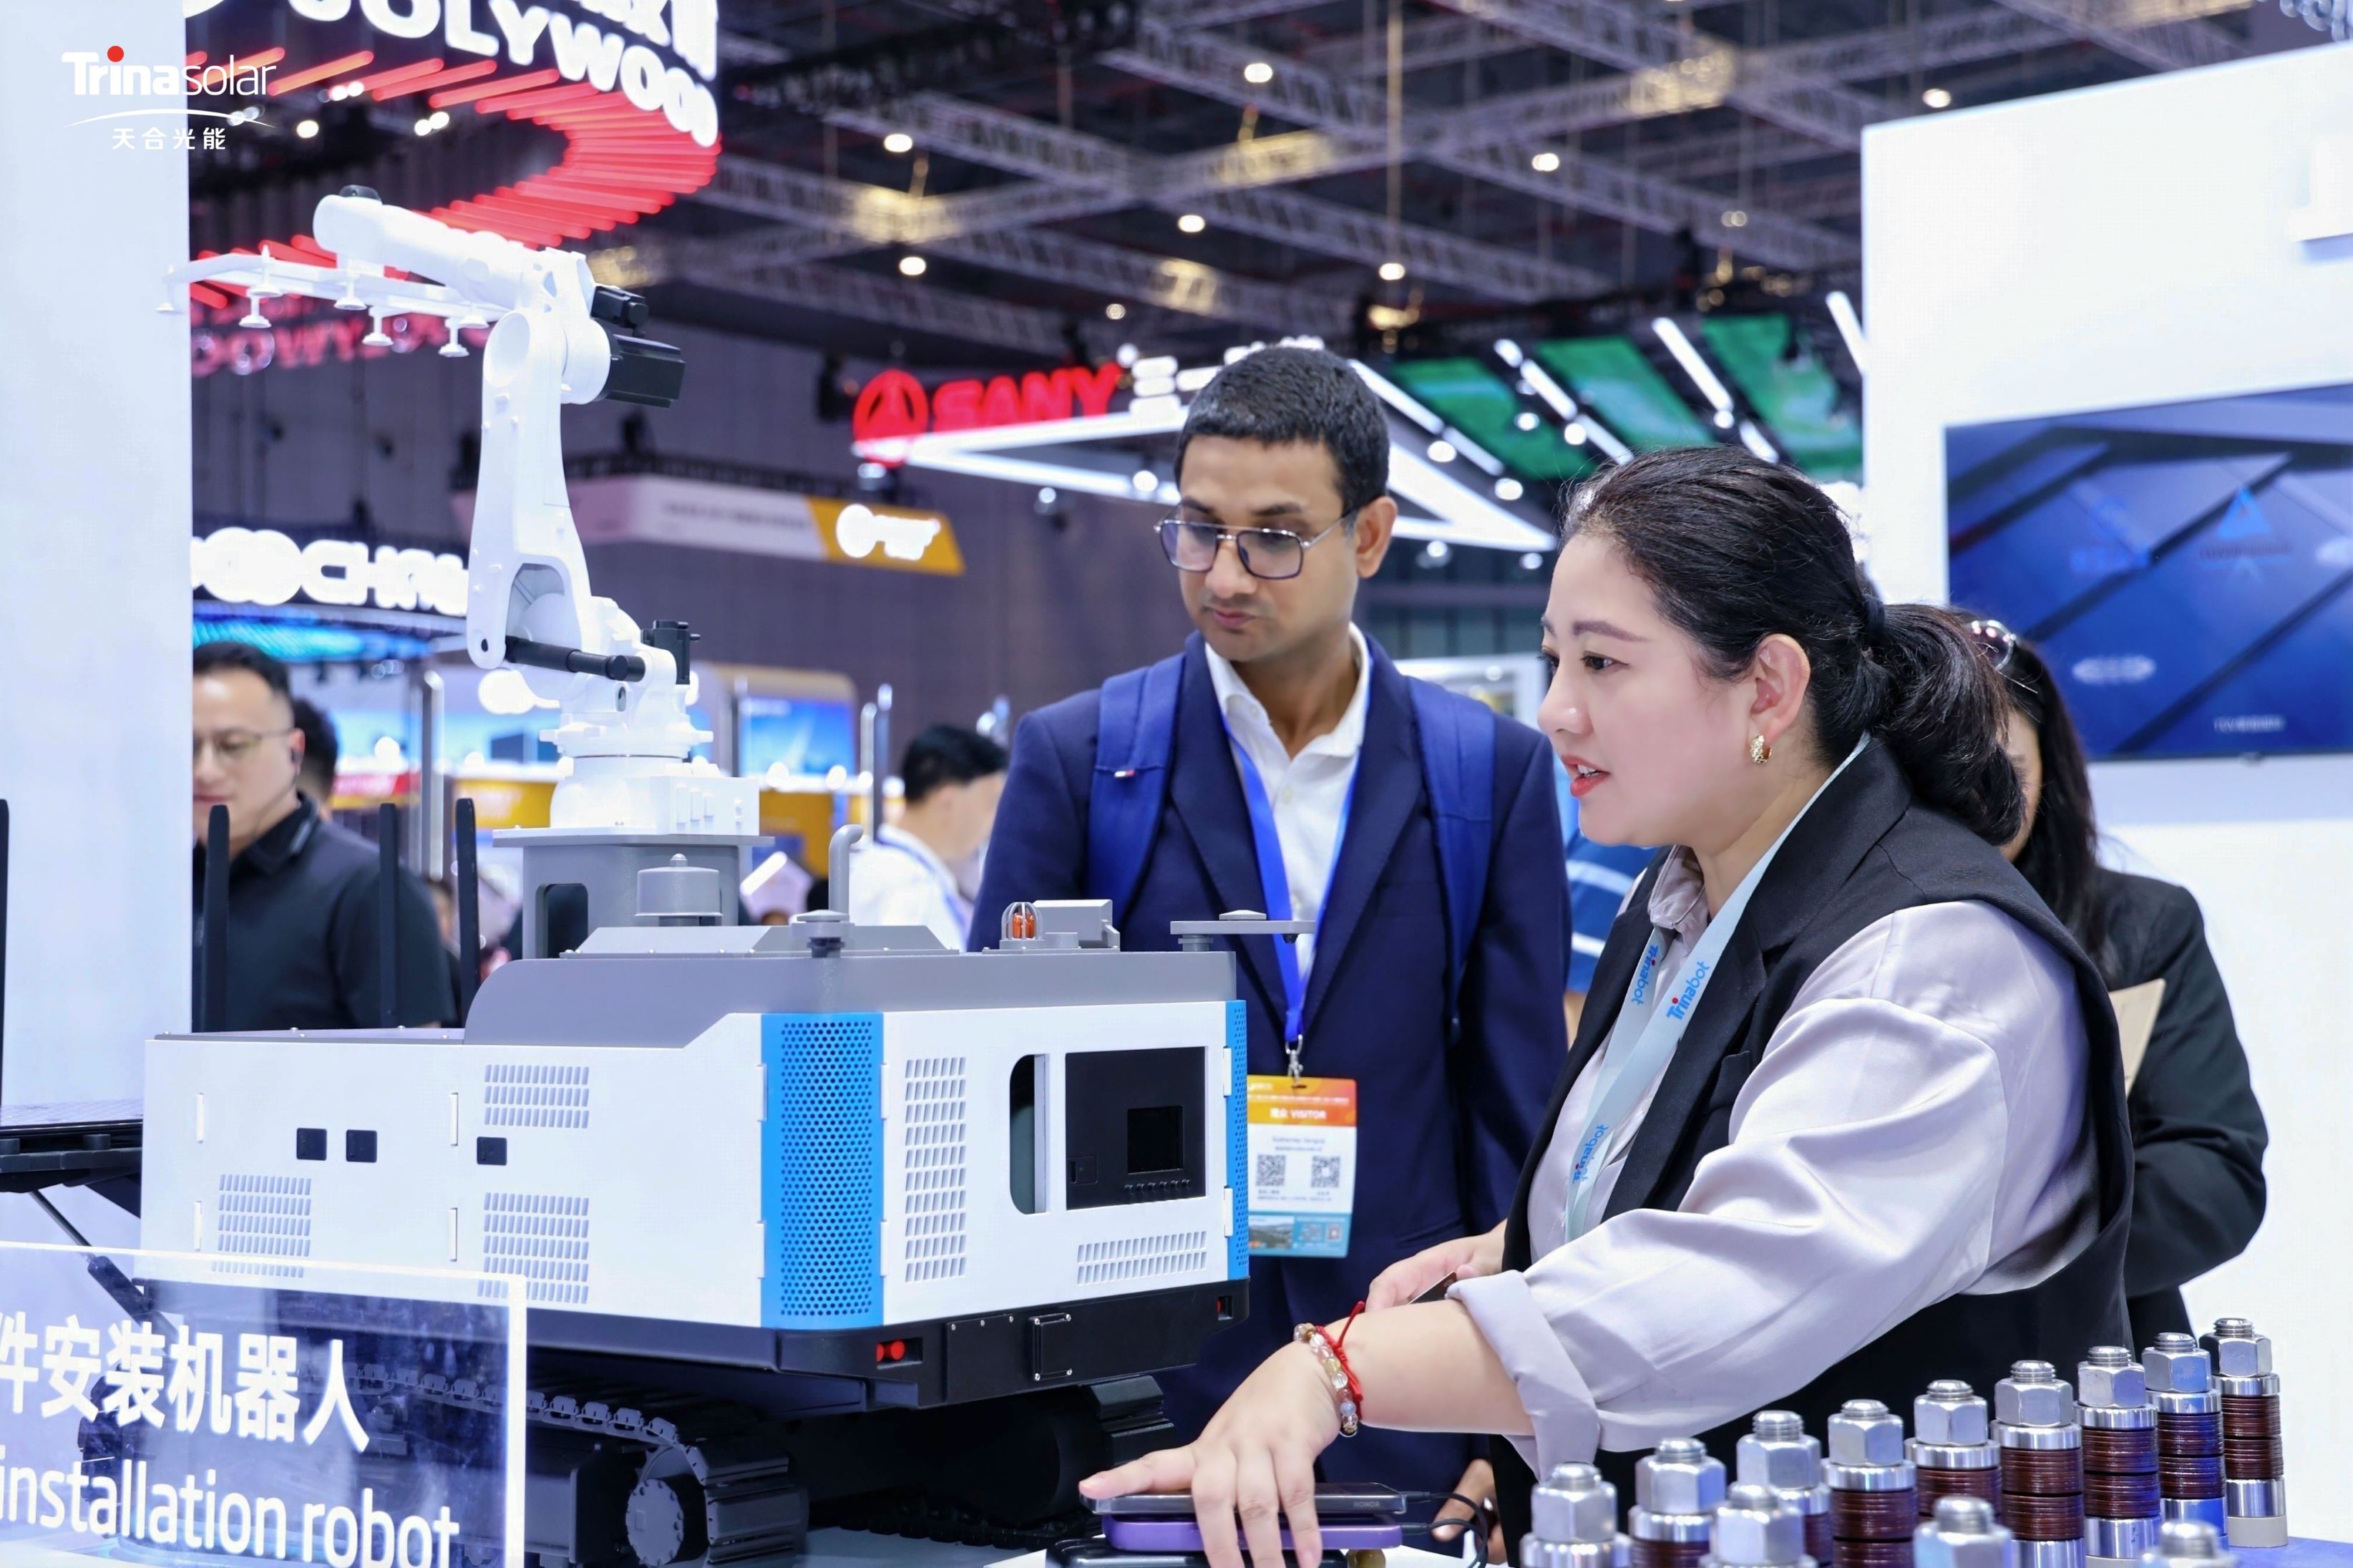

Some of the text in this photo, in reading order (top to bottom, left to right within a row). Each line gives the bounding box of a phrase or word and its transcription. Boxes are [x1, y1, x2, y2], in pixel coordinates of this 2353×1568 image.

[286, 0, 718, 148] OLYWOOD
[932, 362, 1123, 434] SANY
[1630, 943, 1660, 1005] Trinabot
[1665, 960, 1711, 1021] Trinabot
[1290, 1109, 1327, 1120] VISITOR
[0, 1310, 370, 1453] 件安装机器人
[302, 1487, 460, 1568] robot
